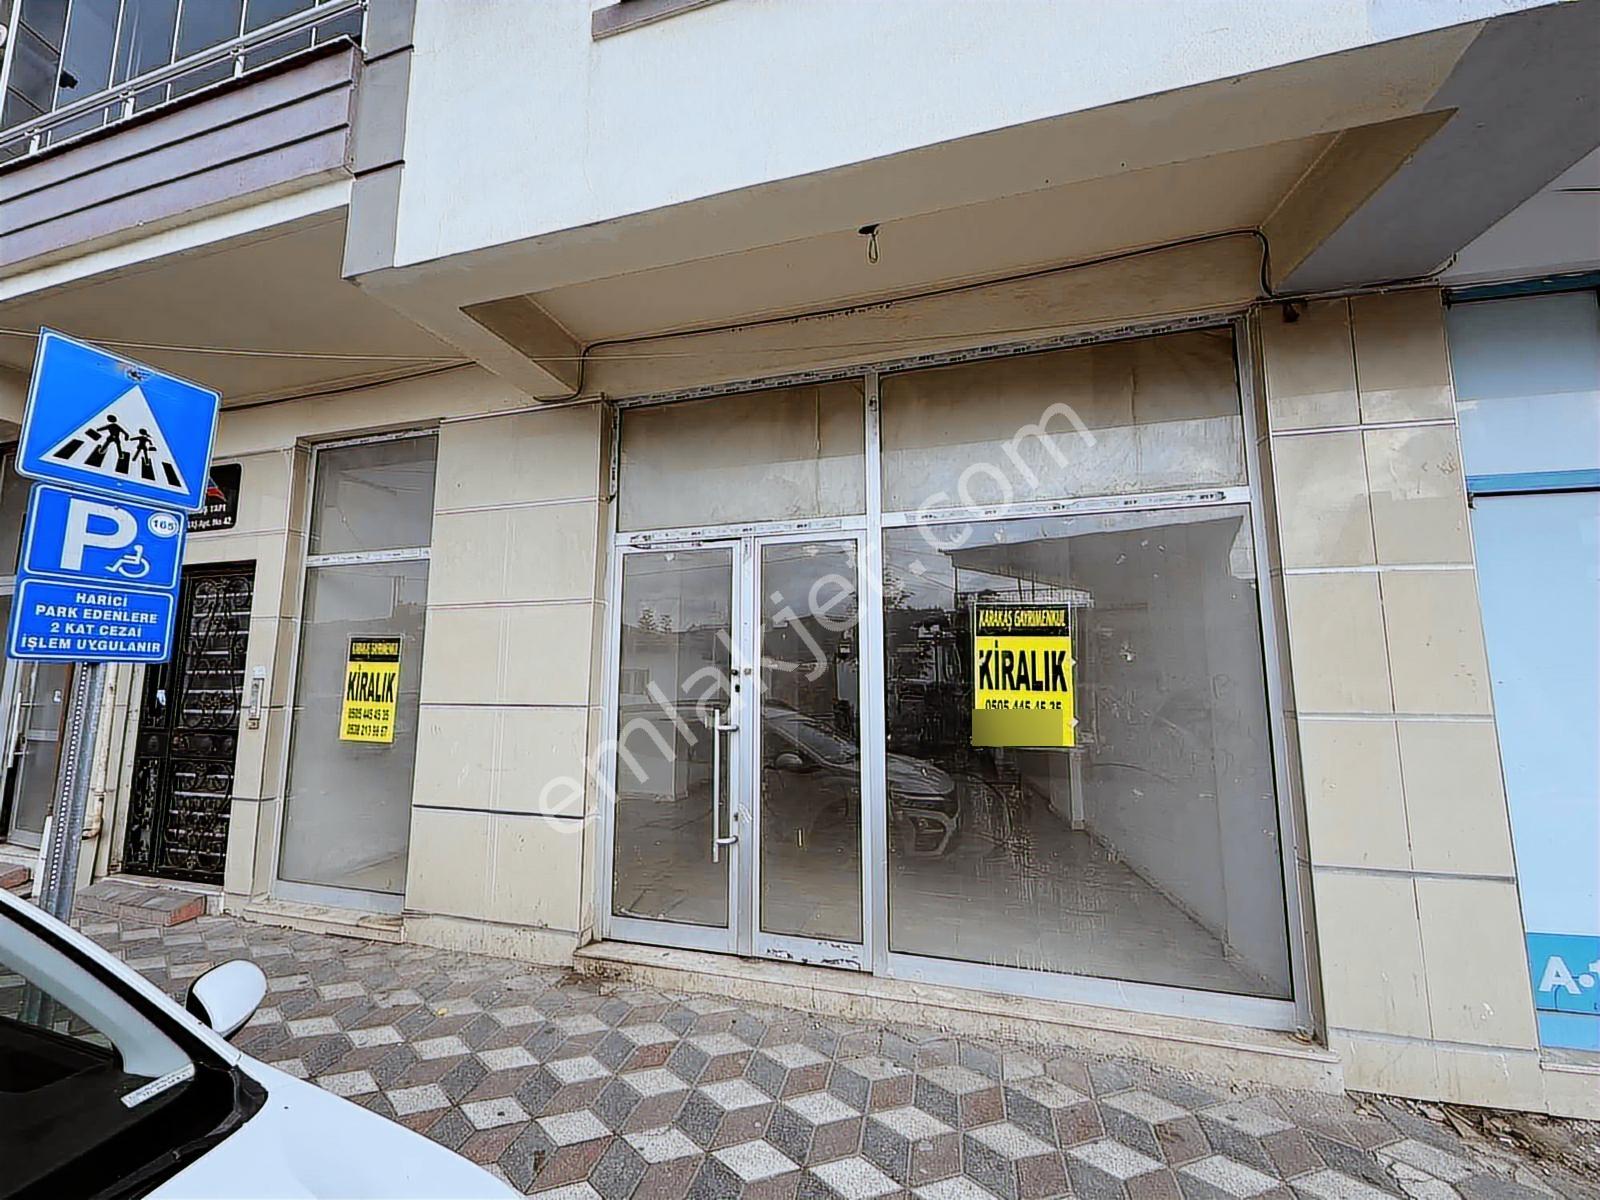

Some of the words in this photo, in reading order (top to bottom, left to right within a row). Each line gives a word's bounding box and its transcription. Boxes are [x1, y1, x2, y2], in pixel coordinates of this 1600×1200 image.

[60, 497, 138, 571] P
[152, 519, 174, 531] 165
[75, 592, 128, 607] HARİCİ
[35, 605, 78, 618] PARK
[83, 608, 158, 624] EDENLERE
[50, 622, 60, 633] 2
[65, 623, 95, 635] KAT
[99, 624, 142, 638] CEZAİ
[21, 633, 71, 651] İŞLEM
[77, 639, 161, 653] UYGULANIR
[979, 640, 1068, 692] KİRALIK
[346, 664, 396, 703] KİRALIK
